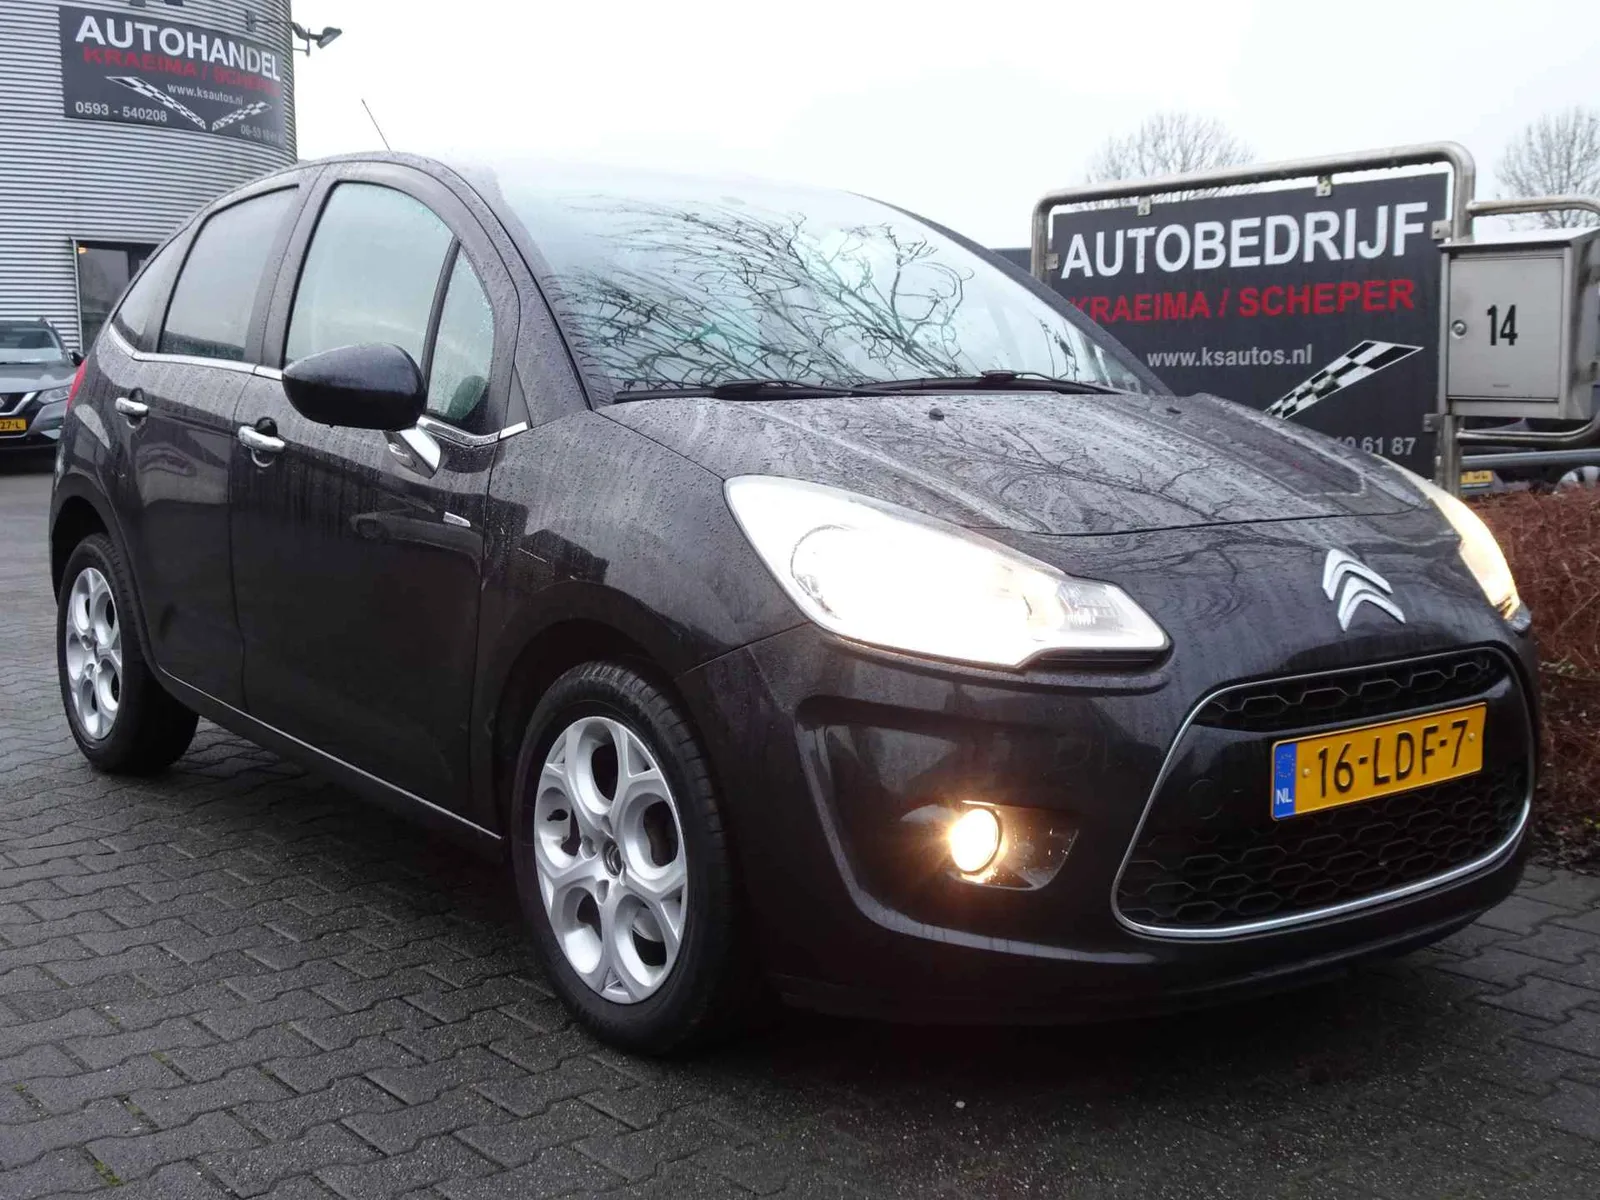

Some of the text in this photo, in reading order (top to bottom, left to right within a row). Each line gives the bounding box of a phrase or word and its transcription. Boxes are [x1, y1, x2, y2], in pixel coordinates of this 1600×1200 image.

[75, 15, 281, 82] AUTOHANDEL
[83, 46, 198, 78] KRAEIMA
[167, 83, 244, 106] www.ksautos.nl
[75, 101, 109, 116] 0593
[122, 106, 167, 122] 540208
[1061, 202, 1428, 279] AUTOBEDRIJF
[1239, 279, 1415, 318] SCHEPER
[1486, 304, 1518, 346] 14
[1146, 344, 1312, 369] www.ksautos.nl
[1362, 436, 1384, 455] 61
[1391, 436, 1417, 455] 87
[1318, 719, 1469, 797] 16-LDF-7
[1276, 787, 1292, 804] NL
